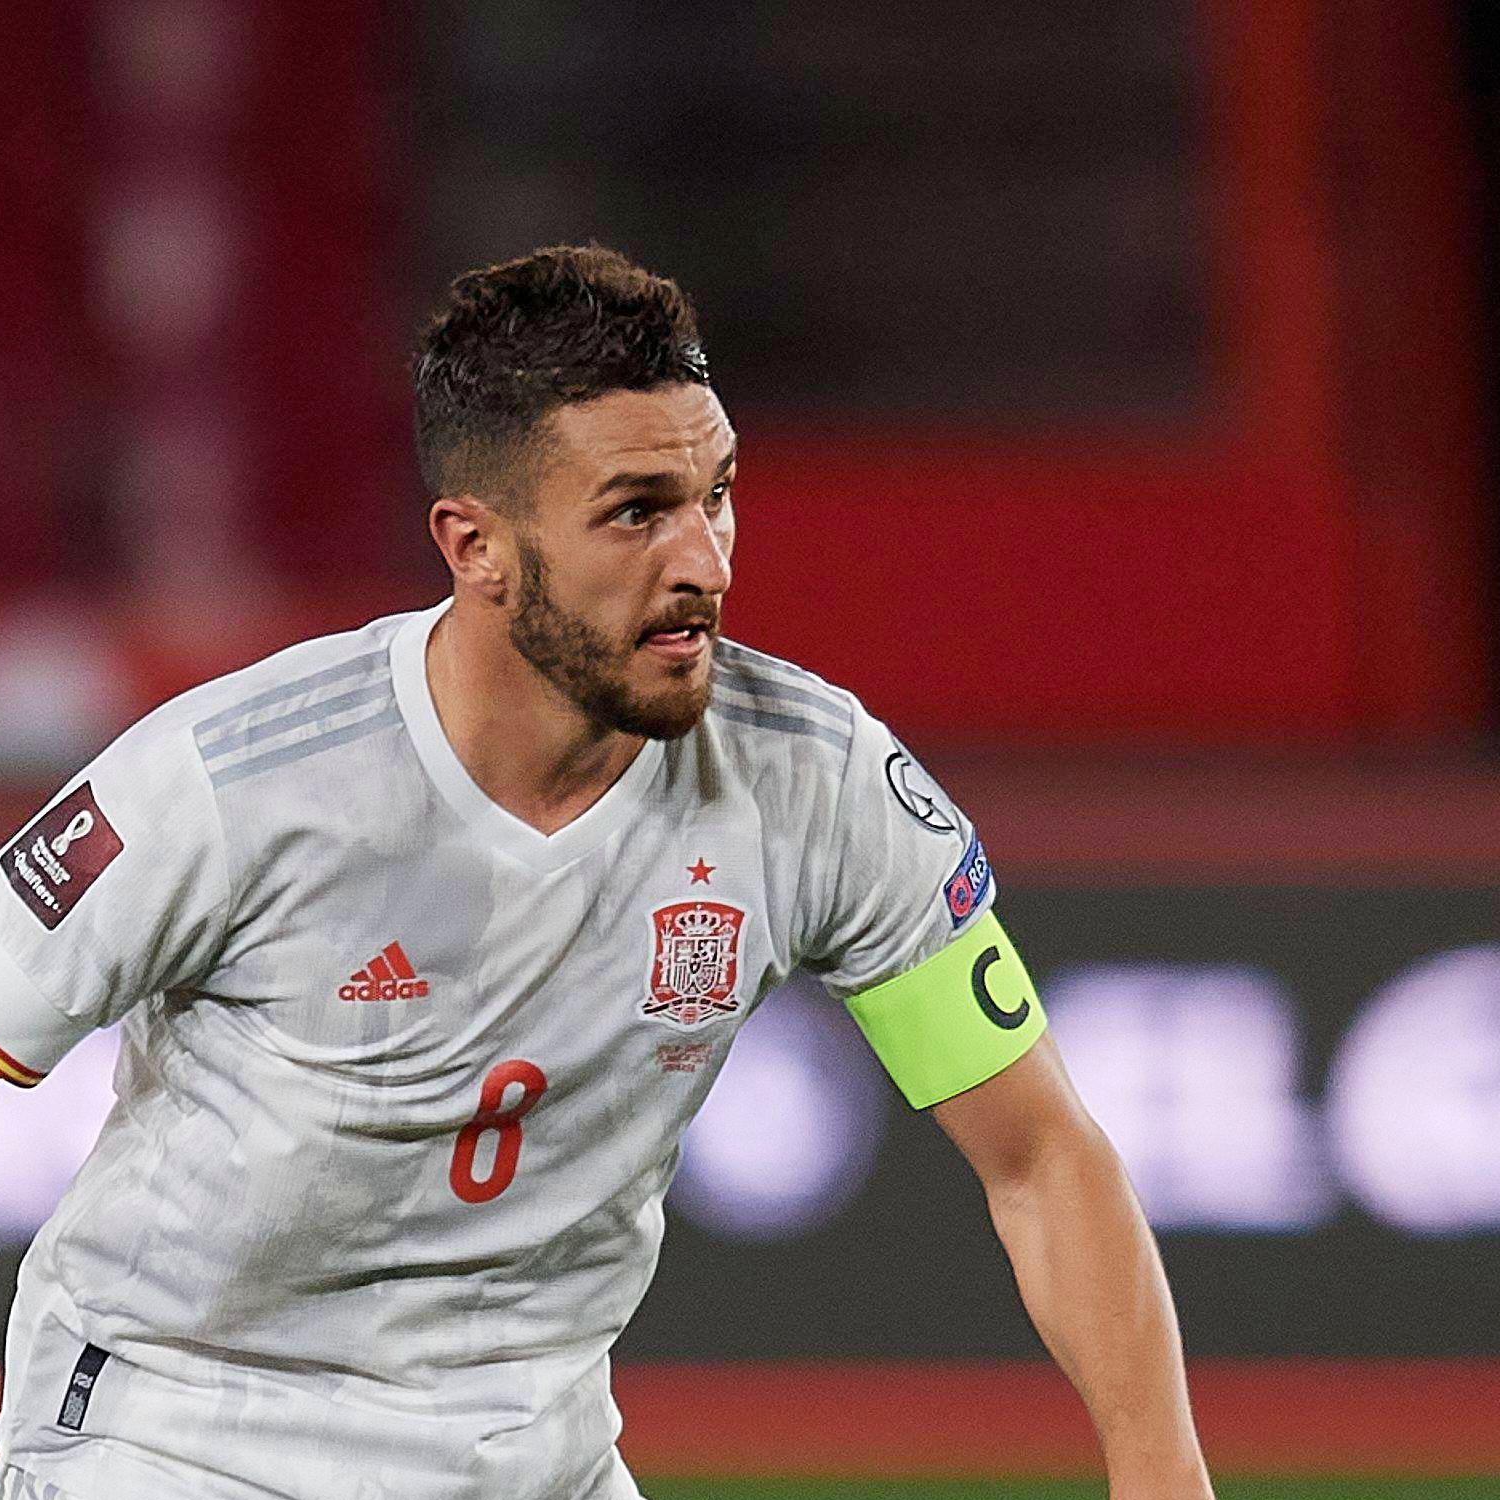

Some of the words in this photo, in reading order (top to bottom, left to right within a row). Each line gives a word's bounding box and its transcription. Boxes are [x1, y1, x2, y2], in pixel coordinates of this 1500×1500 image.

[338, 979, 429, 1001] adidas
[971, 944, 1030, 1031] C
[449, 1058, 548, 1204] 8
